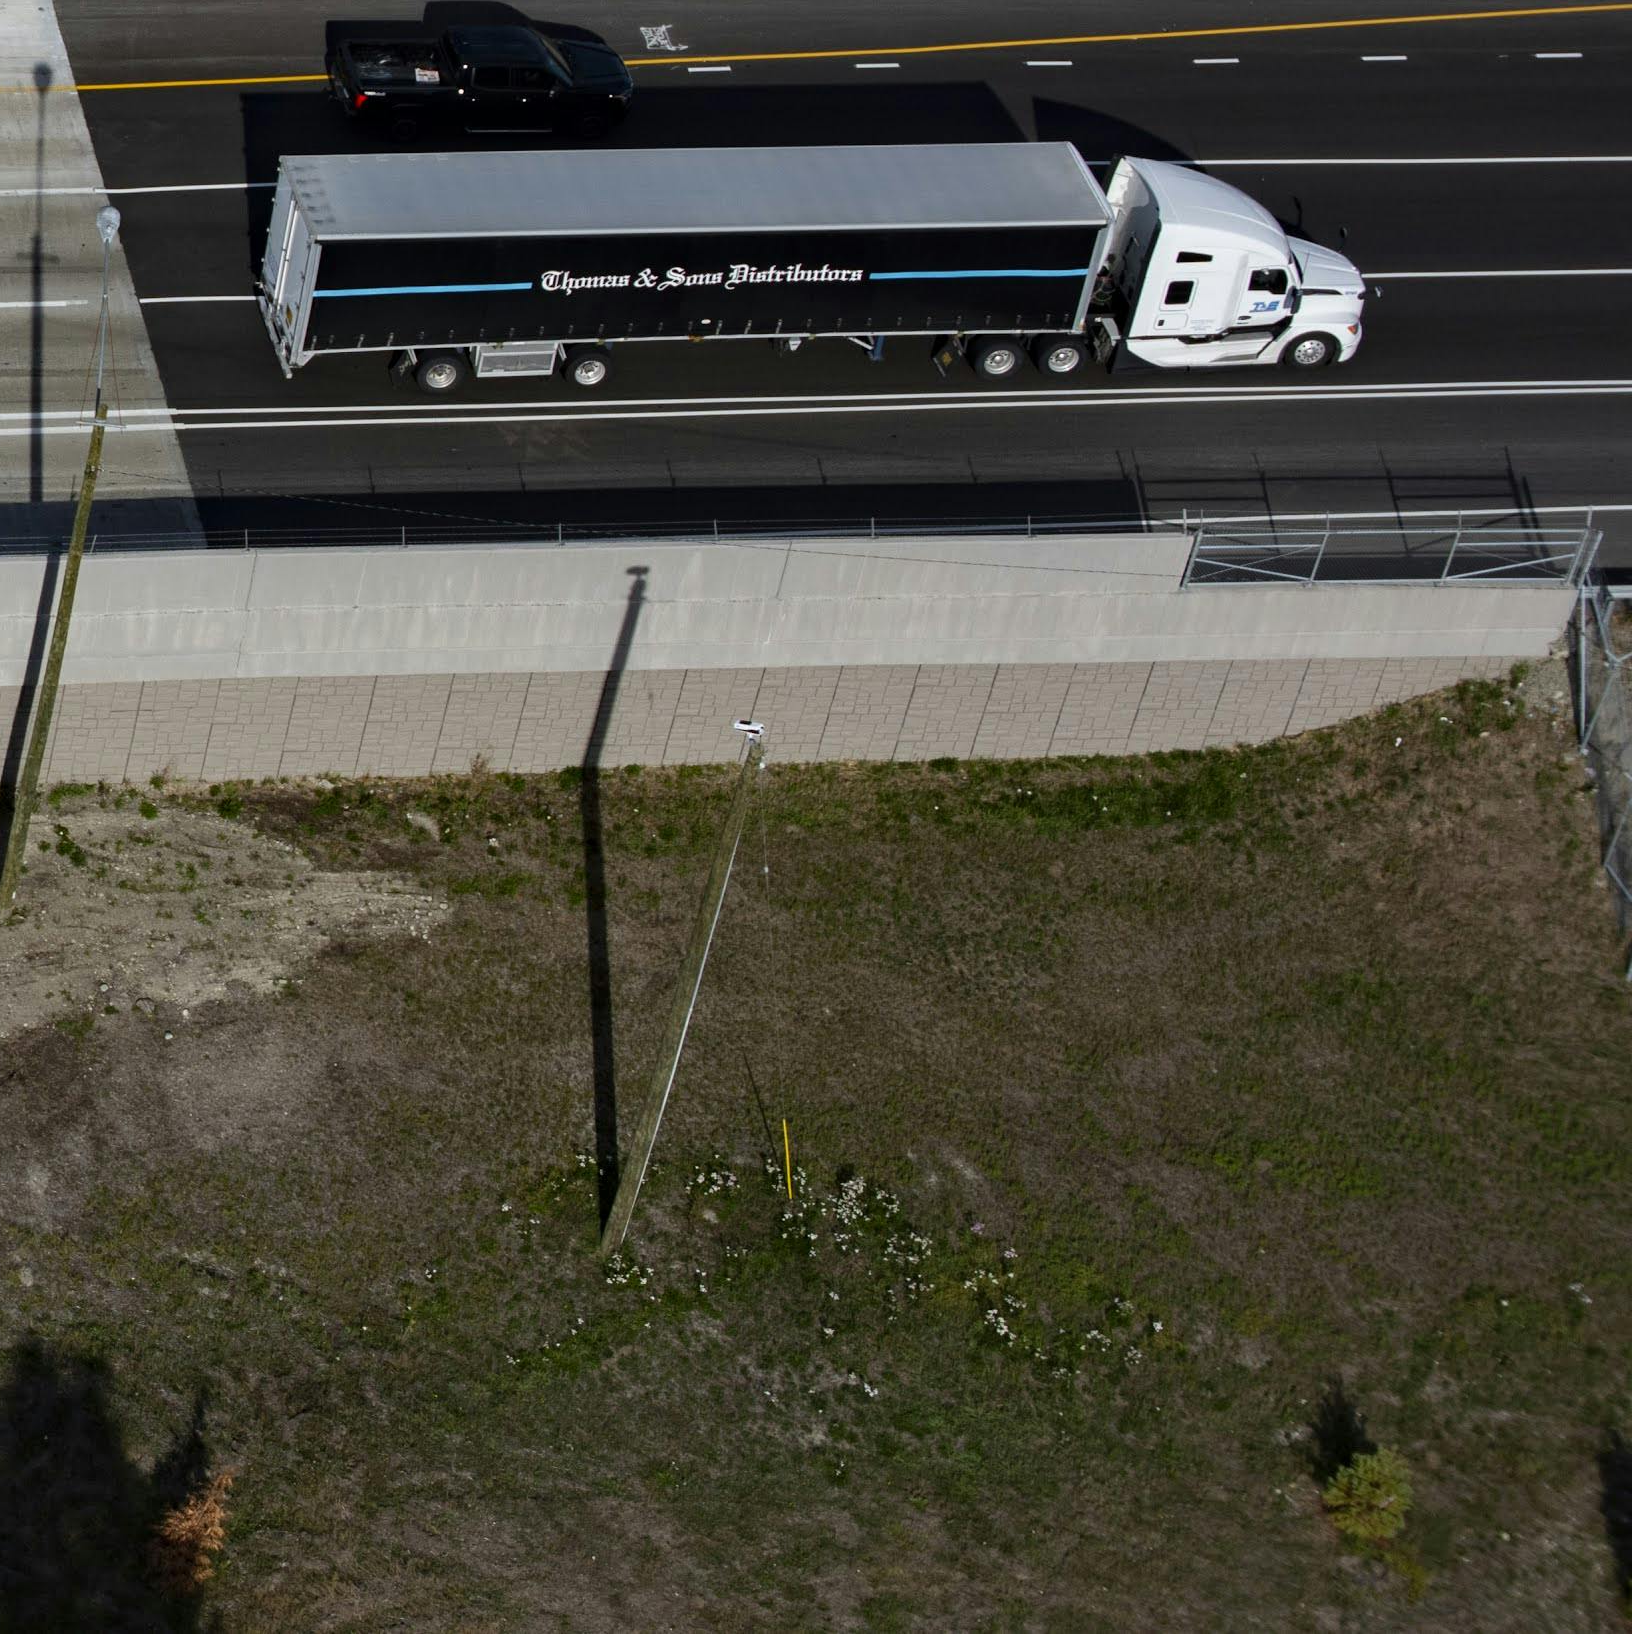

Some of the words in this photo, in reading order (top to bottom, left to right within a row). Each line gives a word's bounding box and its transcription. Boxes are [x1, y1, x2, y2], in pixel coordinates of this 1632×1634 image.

[541, 270, 631, 295] Thomas
[633, 268, 658, 289] &
[657, 266, 723, 290] Sons
[725, 263, 864, 289] Distributors
